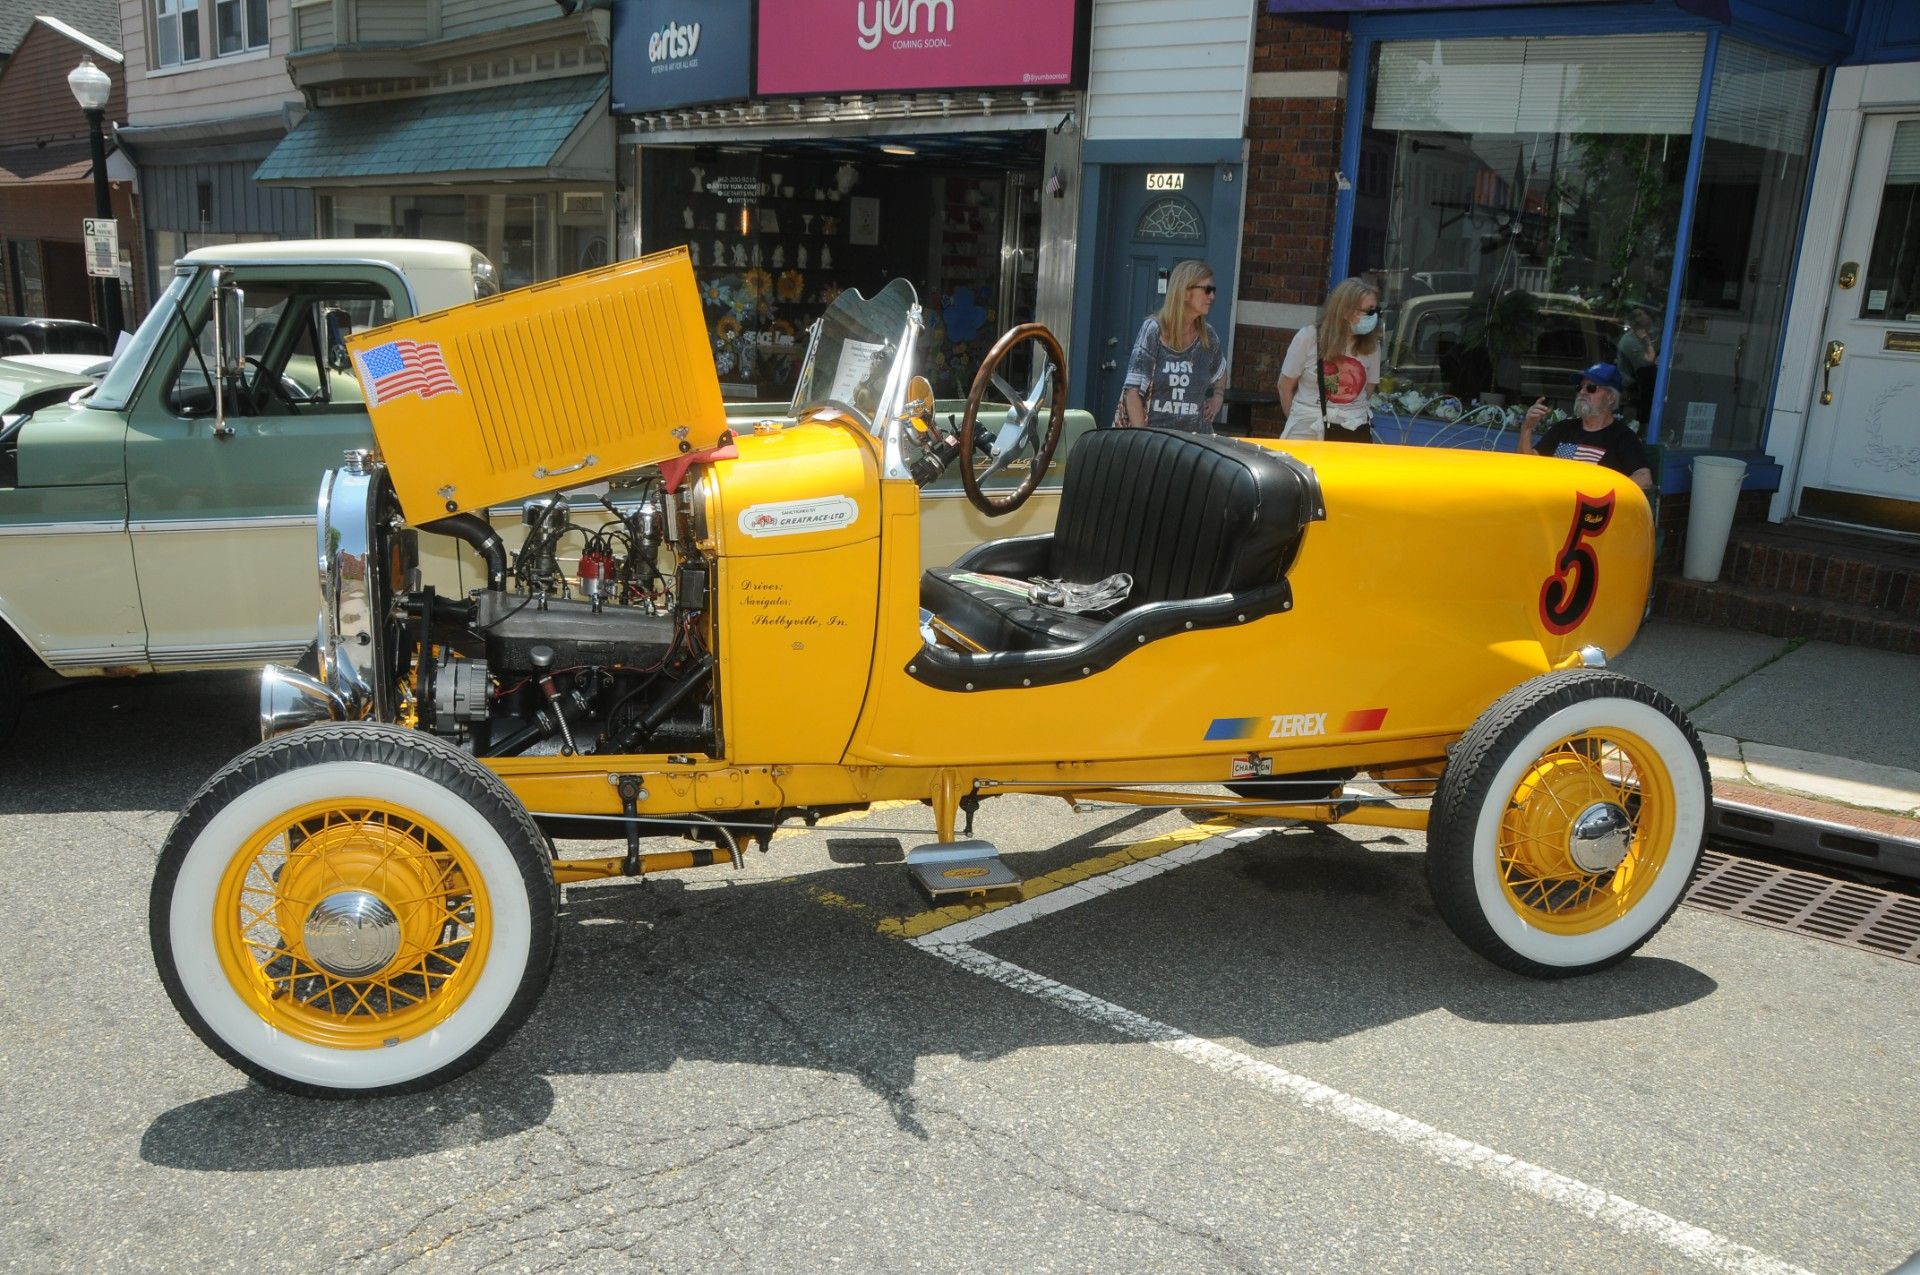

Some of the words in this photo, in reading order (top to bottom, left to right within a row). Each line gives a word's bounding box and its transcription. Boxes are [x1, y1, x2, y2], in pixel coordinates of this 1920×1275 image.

[858, 0, 954, 50] yum
[648, 21, 700, 62] artsy
[892, 39, 922, 50] COMING
[1148, 175, 1181, 188] 504A
[86, 222, 95, 235] 2
[1162, 361, 1193, 373] JUST
[1169, 374, 1190, 387] DO
[1172, 387, 1186, 401] IT
[1539, 489, 1616, 636] 5
[741, 580, 783, 591] Driver:
[740, 596, 792, 609] Navigator:
[752, 615, 821, 629] Shelbyville,
[1268, 713, 1327, 738] ZEREX
